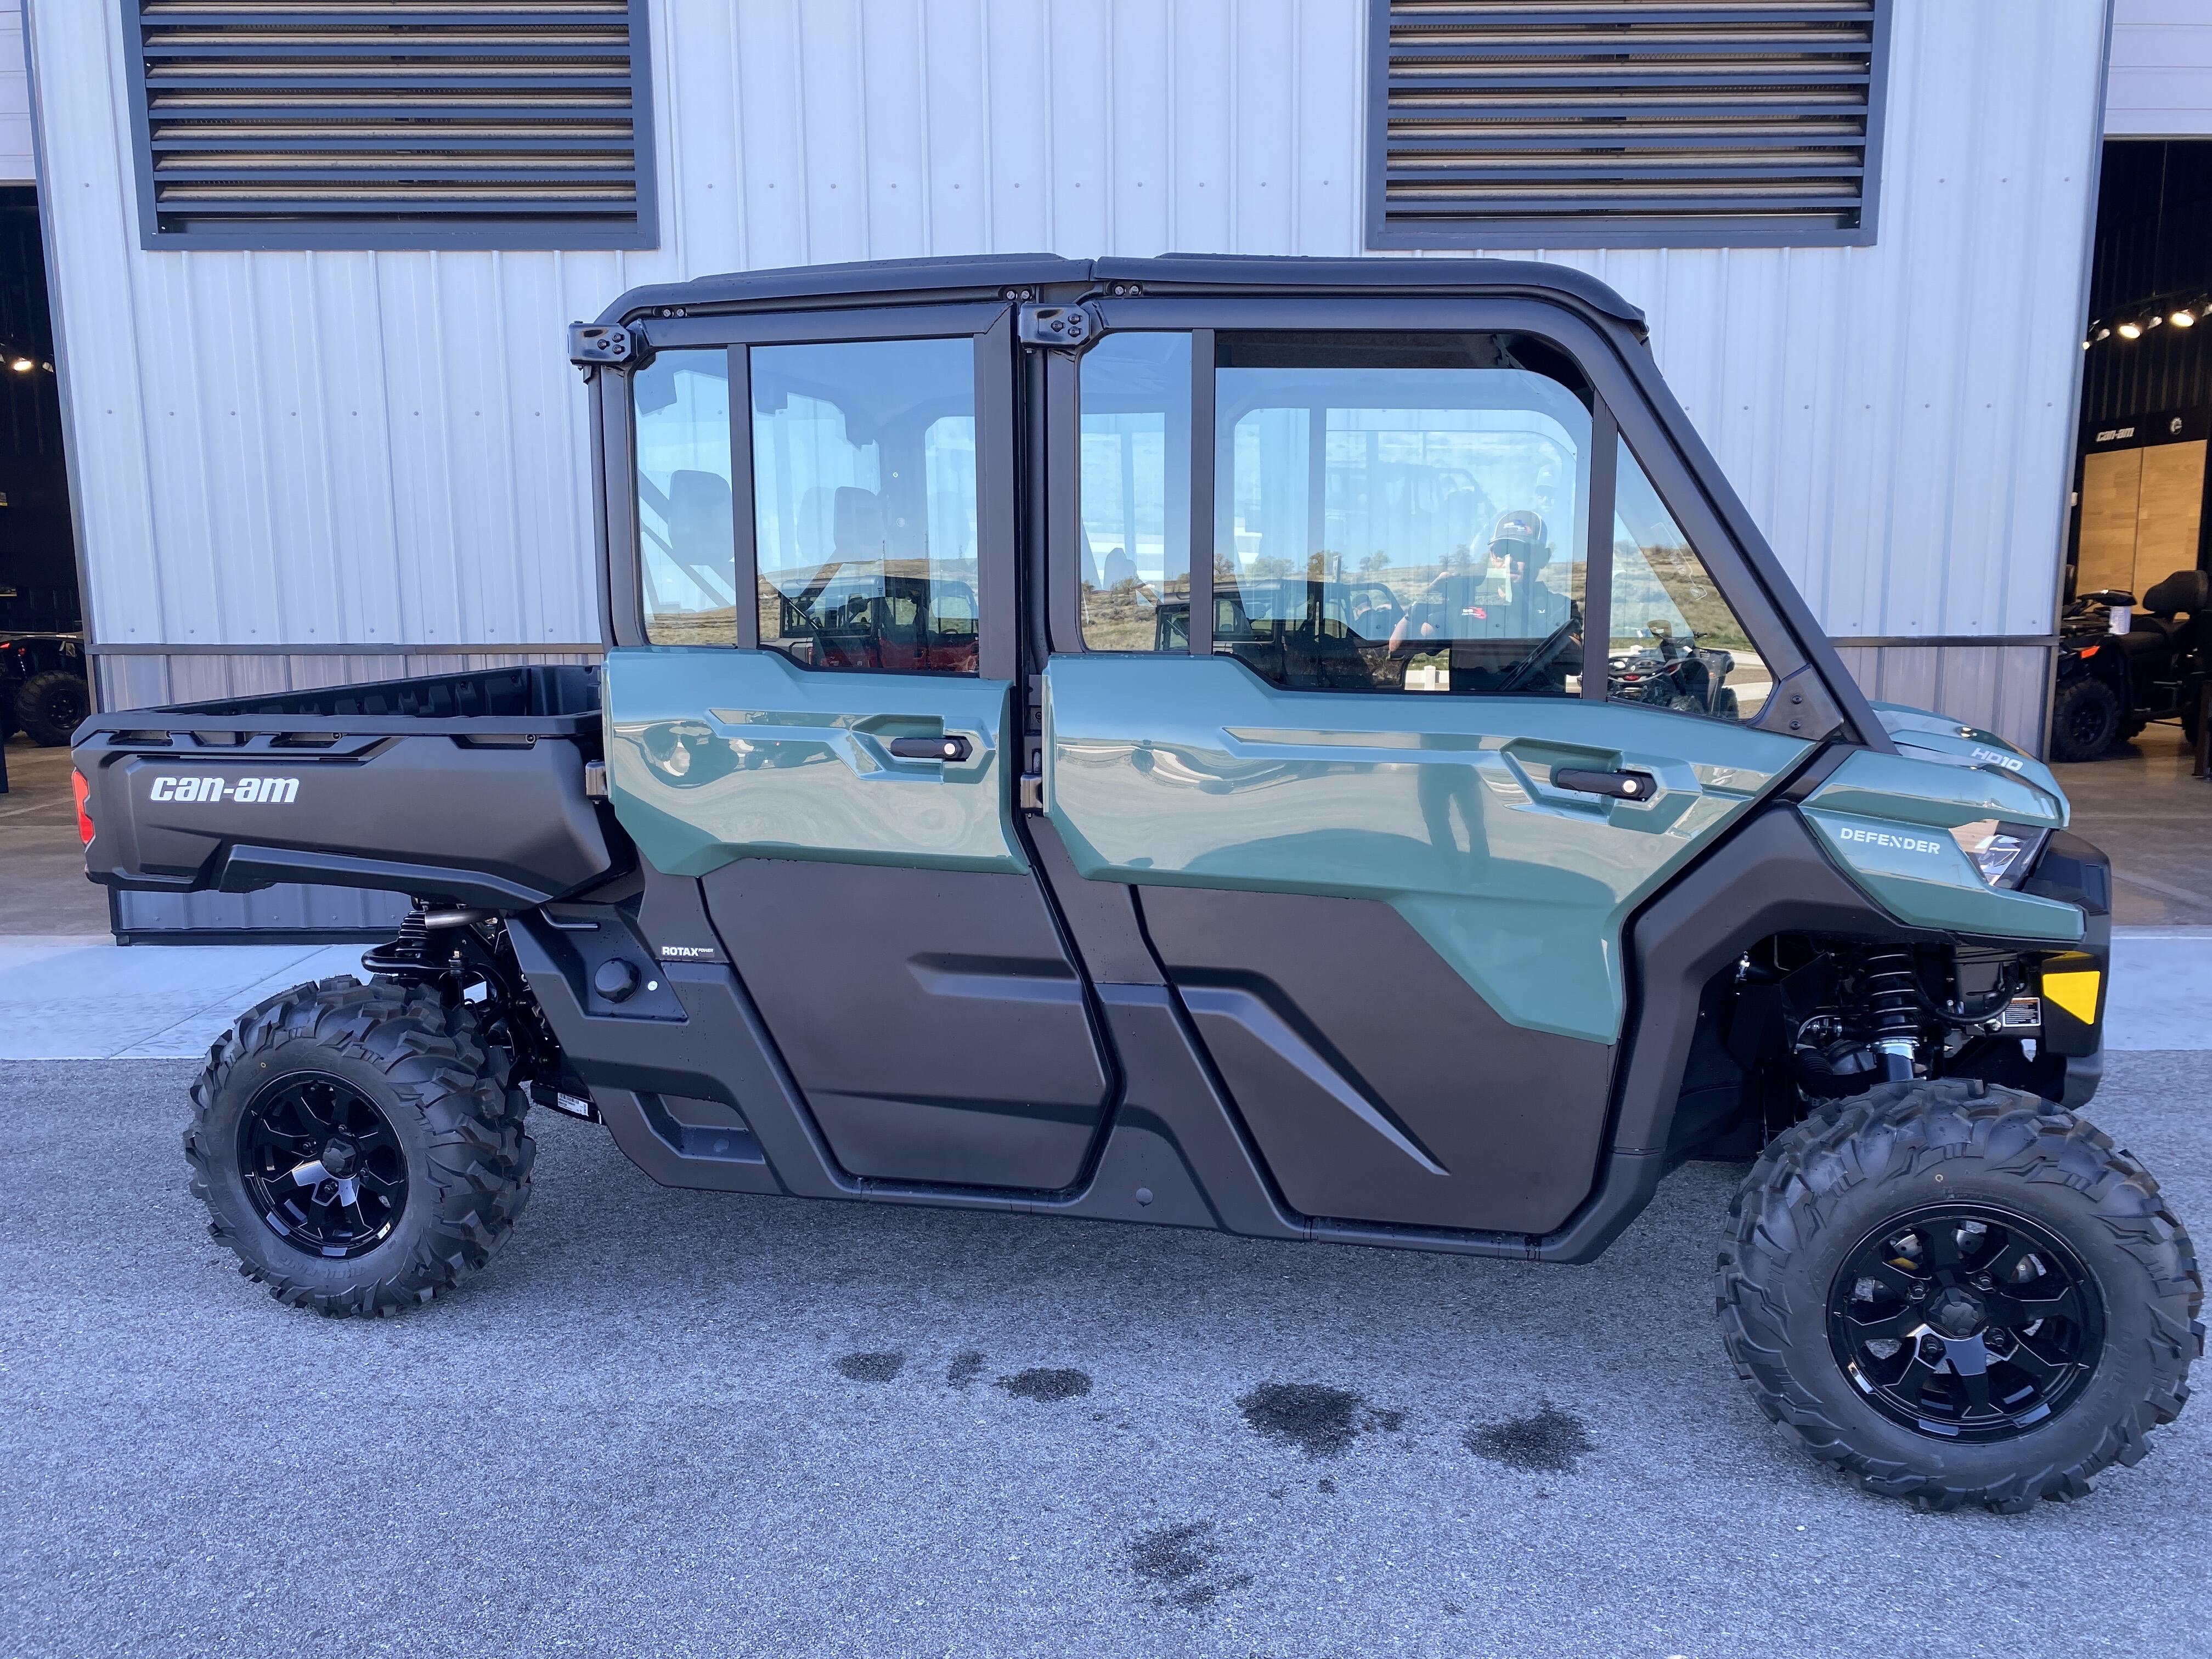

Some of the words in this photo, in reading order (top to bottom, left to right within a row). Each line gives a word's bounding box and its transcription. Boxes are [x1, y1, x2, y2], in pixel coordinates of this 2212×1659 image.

[1971, 748, 2024, 771] HD10
[150, 777, 300, 803] can-am
[1841, 827, 1940, 855] DEFENDER
[662, 946, 699, 956] ROTAX
